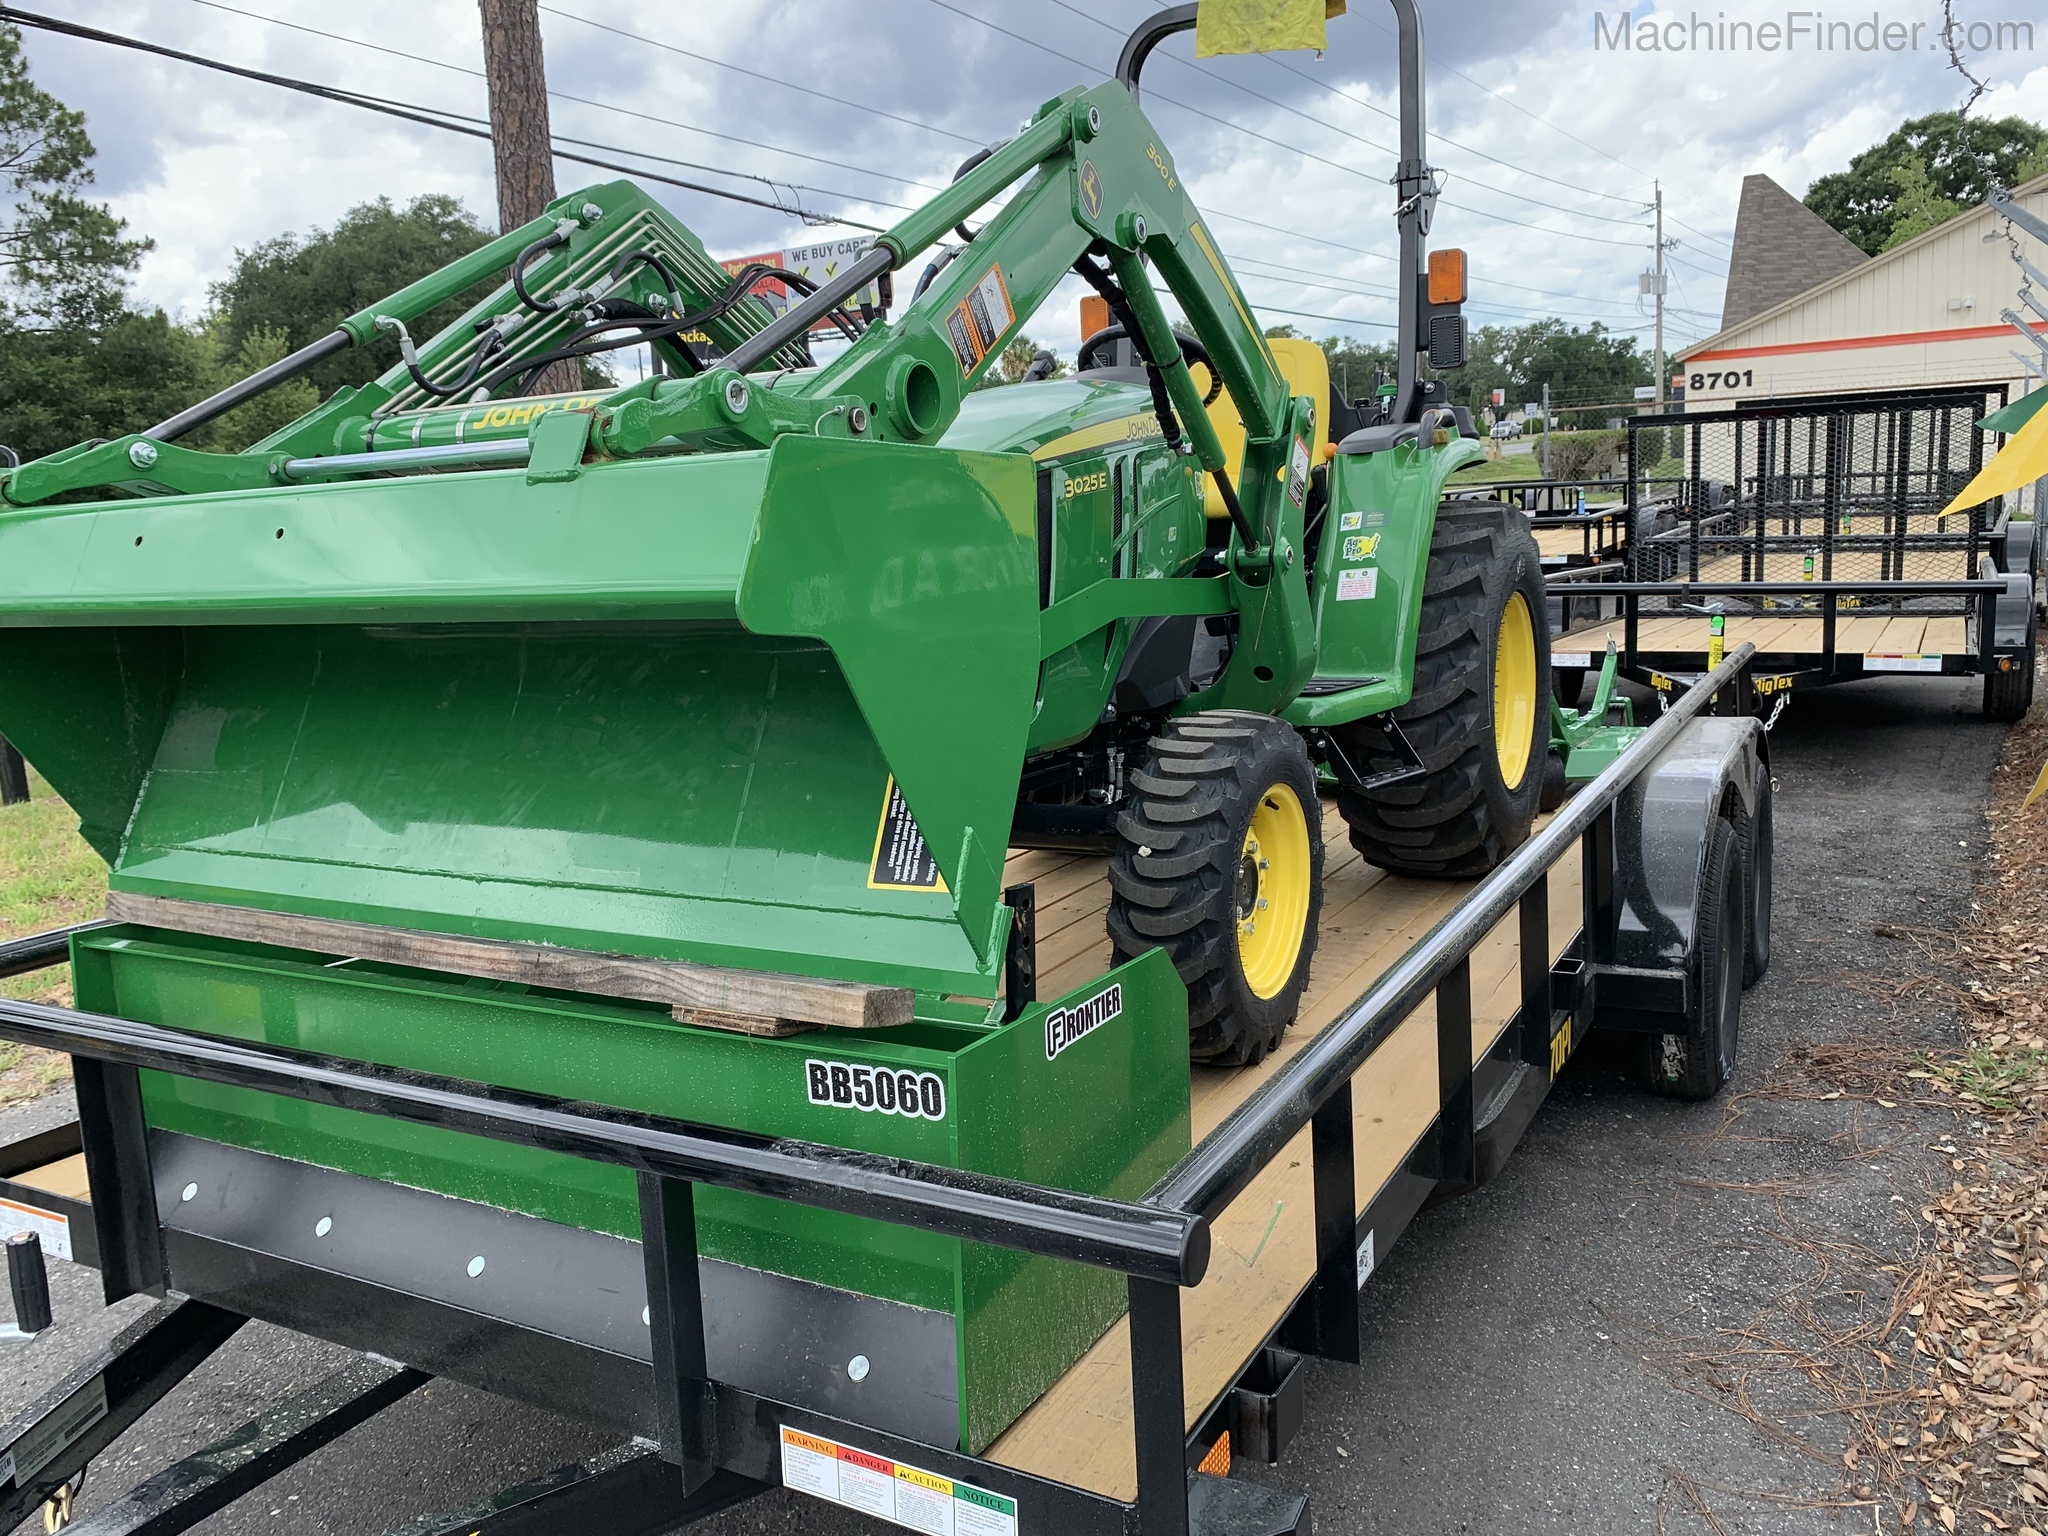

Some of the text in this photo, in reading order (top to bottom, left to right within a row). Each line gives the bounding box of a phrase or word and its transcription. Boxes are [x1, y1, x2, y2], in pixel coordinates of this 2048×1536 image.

[792, 249, 808, 262] WE
[812, 245, 833, 259] BUY
[1690, 369, 1753, 390] 8701
[1064, 472, 1107, 500] 3025E
[1346, 547, 1362, 556] Pro
[1047, 986, 1121, 1058] FRONTIER
[808, 1063, 942, 1117] BB5060
[787, 1433, 833, 1454] WARNING
[852, 1454, 889, 1473] DANGER
[907, 1472, 949, 1491] CAUTION
[963, 1489, 1004, 1511] NOTICE
